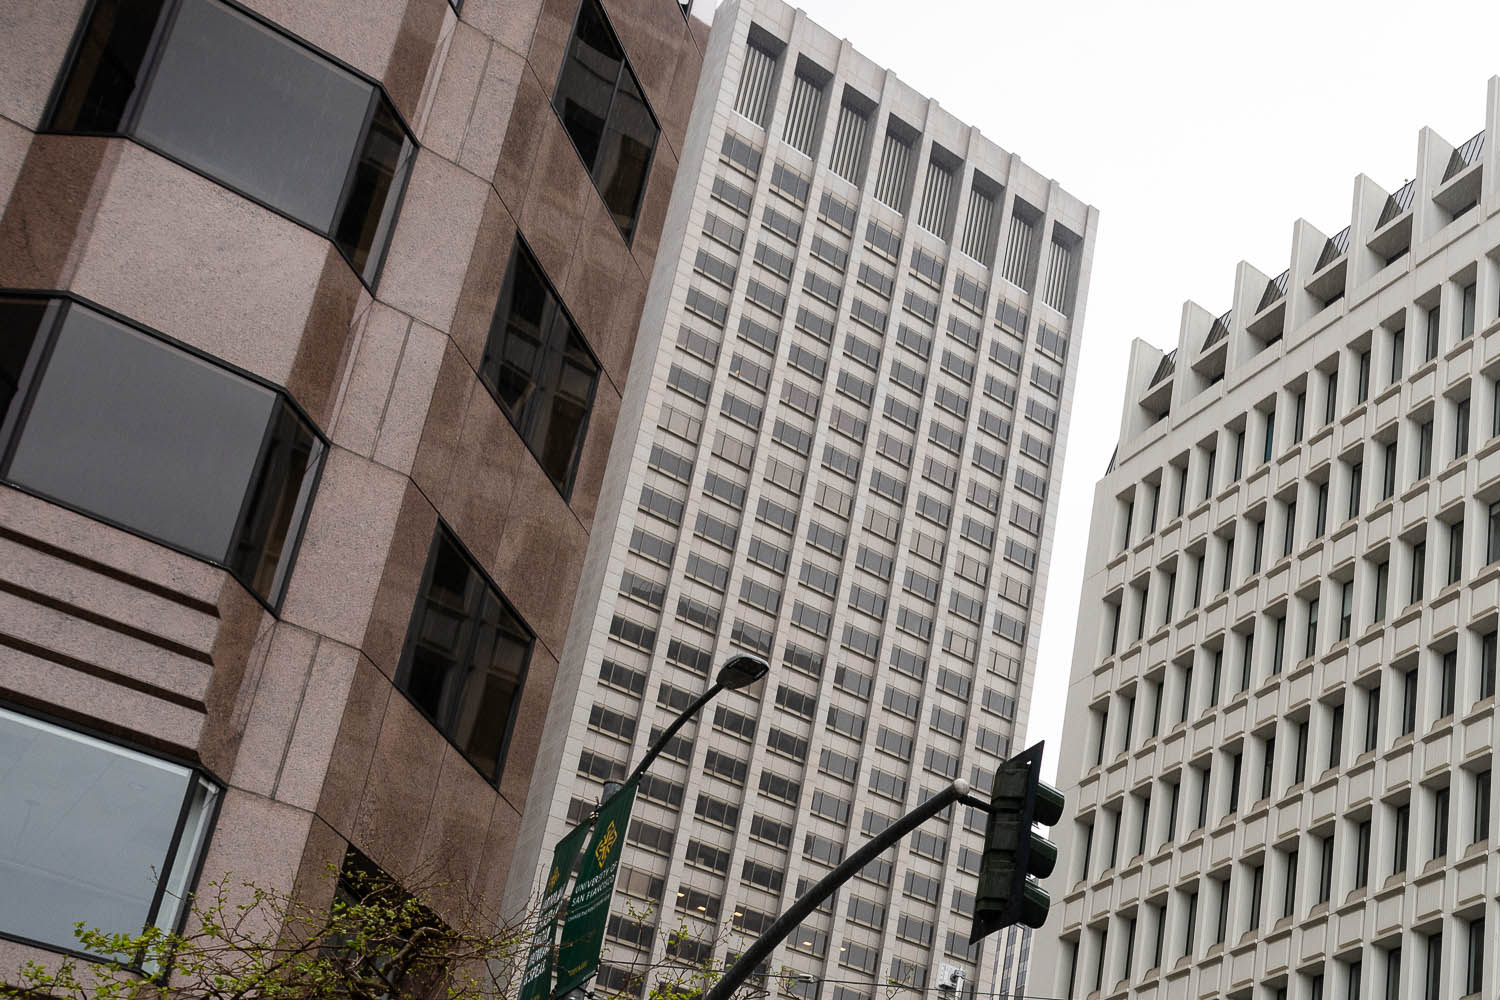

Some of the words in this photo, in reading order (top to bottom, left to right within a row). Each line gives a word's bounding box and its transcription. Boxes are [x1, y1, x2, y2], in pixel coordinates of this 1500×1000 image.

[572, 894, 585, 906] SAN
[586, 874, 615, 900] FRANCISCO
[575, 868, 609, 894] UNIVERSITY
